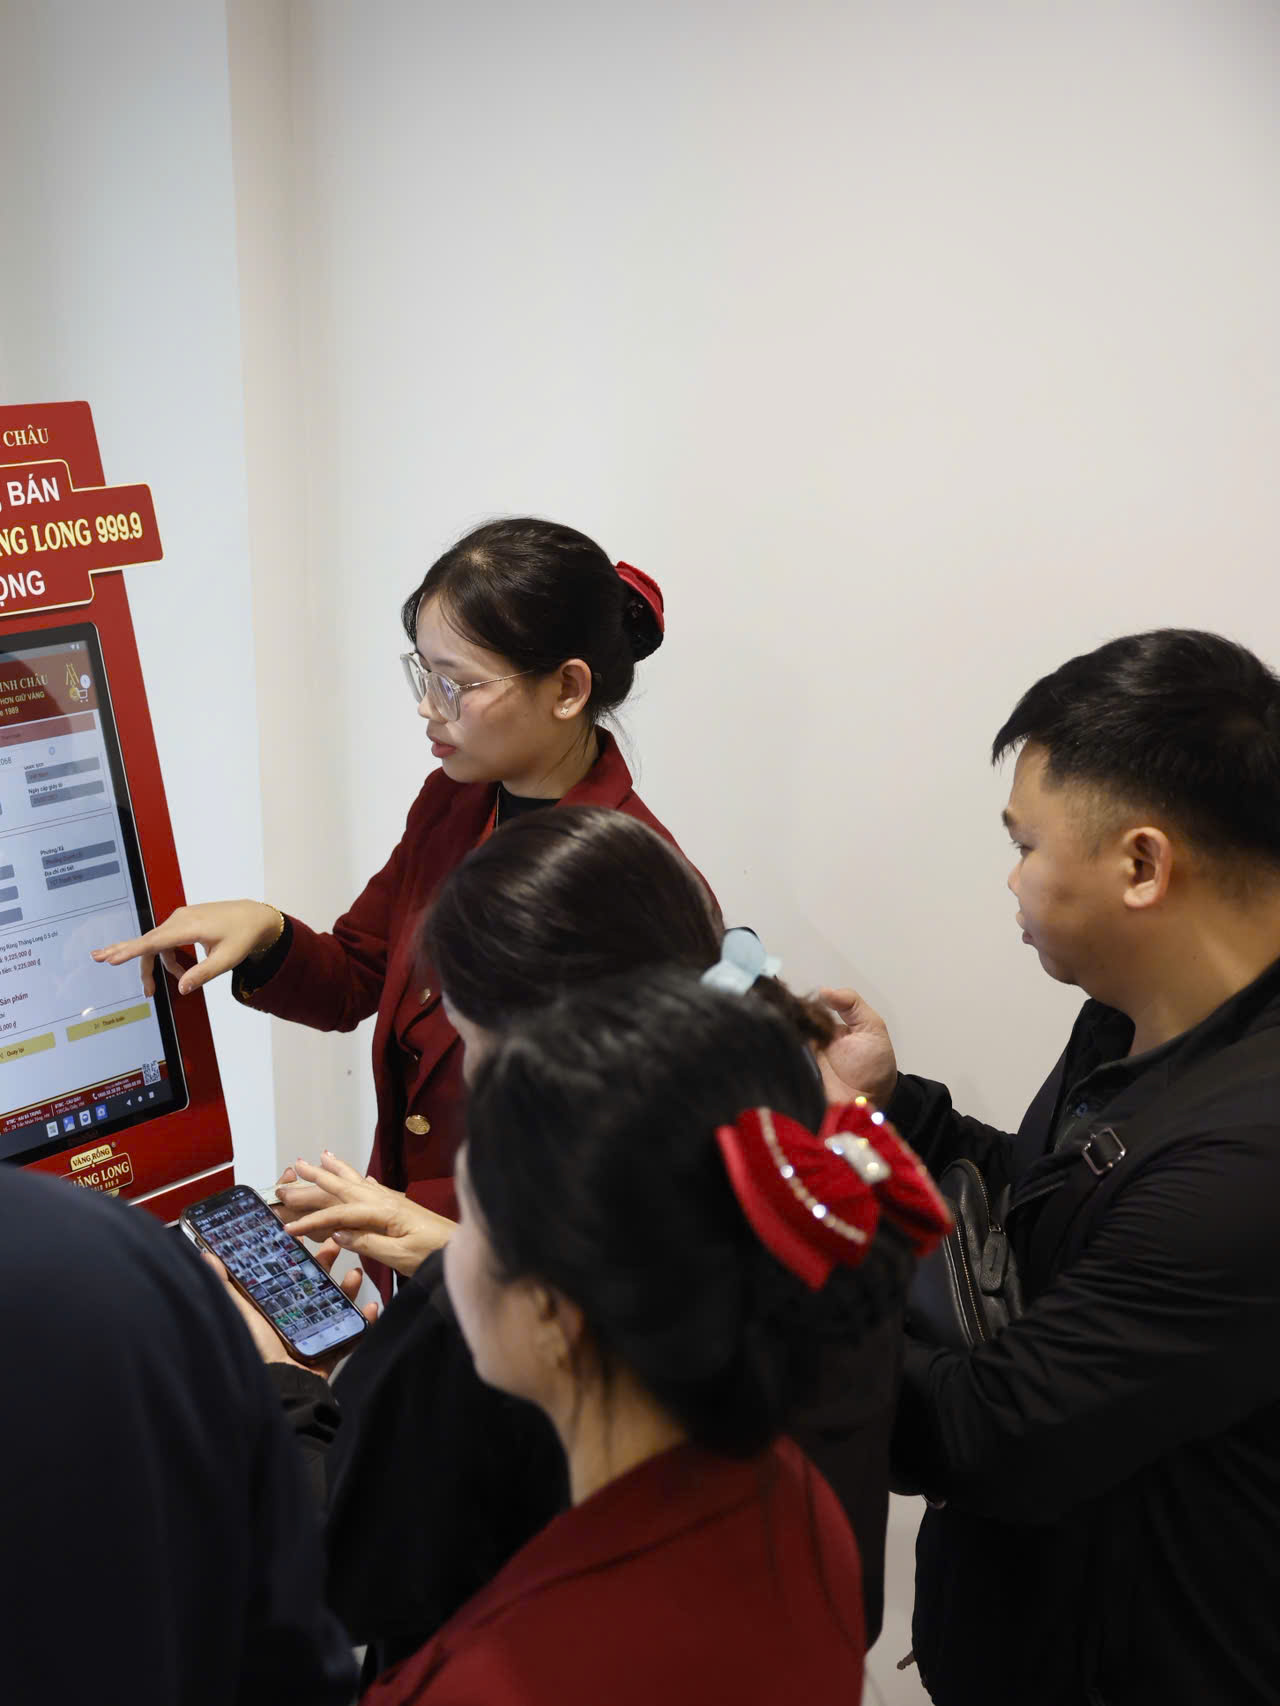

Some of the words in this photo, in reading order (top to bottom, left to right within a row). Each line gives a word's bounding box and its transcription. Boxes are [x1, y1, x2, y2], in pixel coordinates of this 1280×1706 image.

[3, 423, 49, 447] CHÂU
[8, 474, 61, 506] BÁN
[32, 517, 92, 550] LONG
[94, 511, 143, 543] 999.9
[19, 673, 49, 688] CHÂU
[4, 706, 19, 715] 1989
[11, 992, 29, 1004] phẩm
[72, 1154, 92, 1168] VÀNG
[92, 1147, 110, 1160] RỒNG
[101, 1161, 130, 1181] LONG
